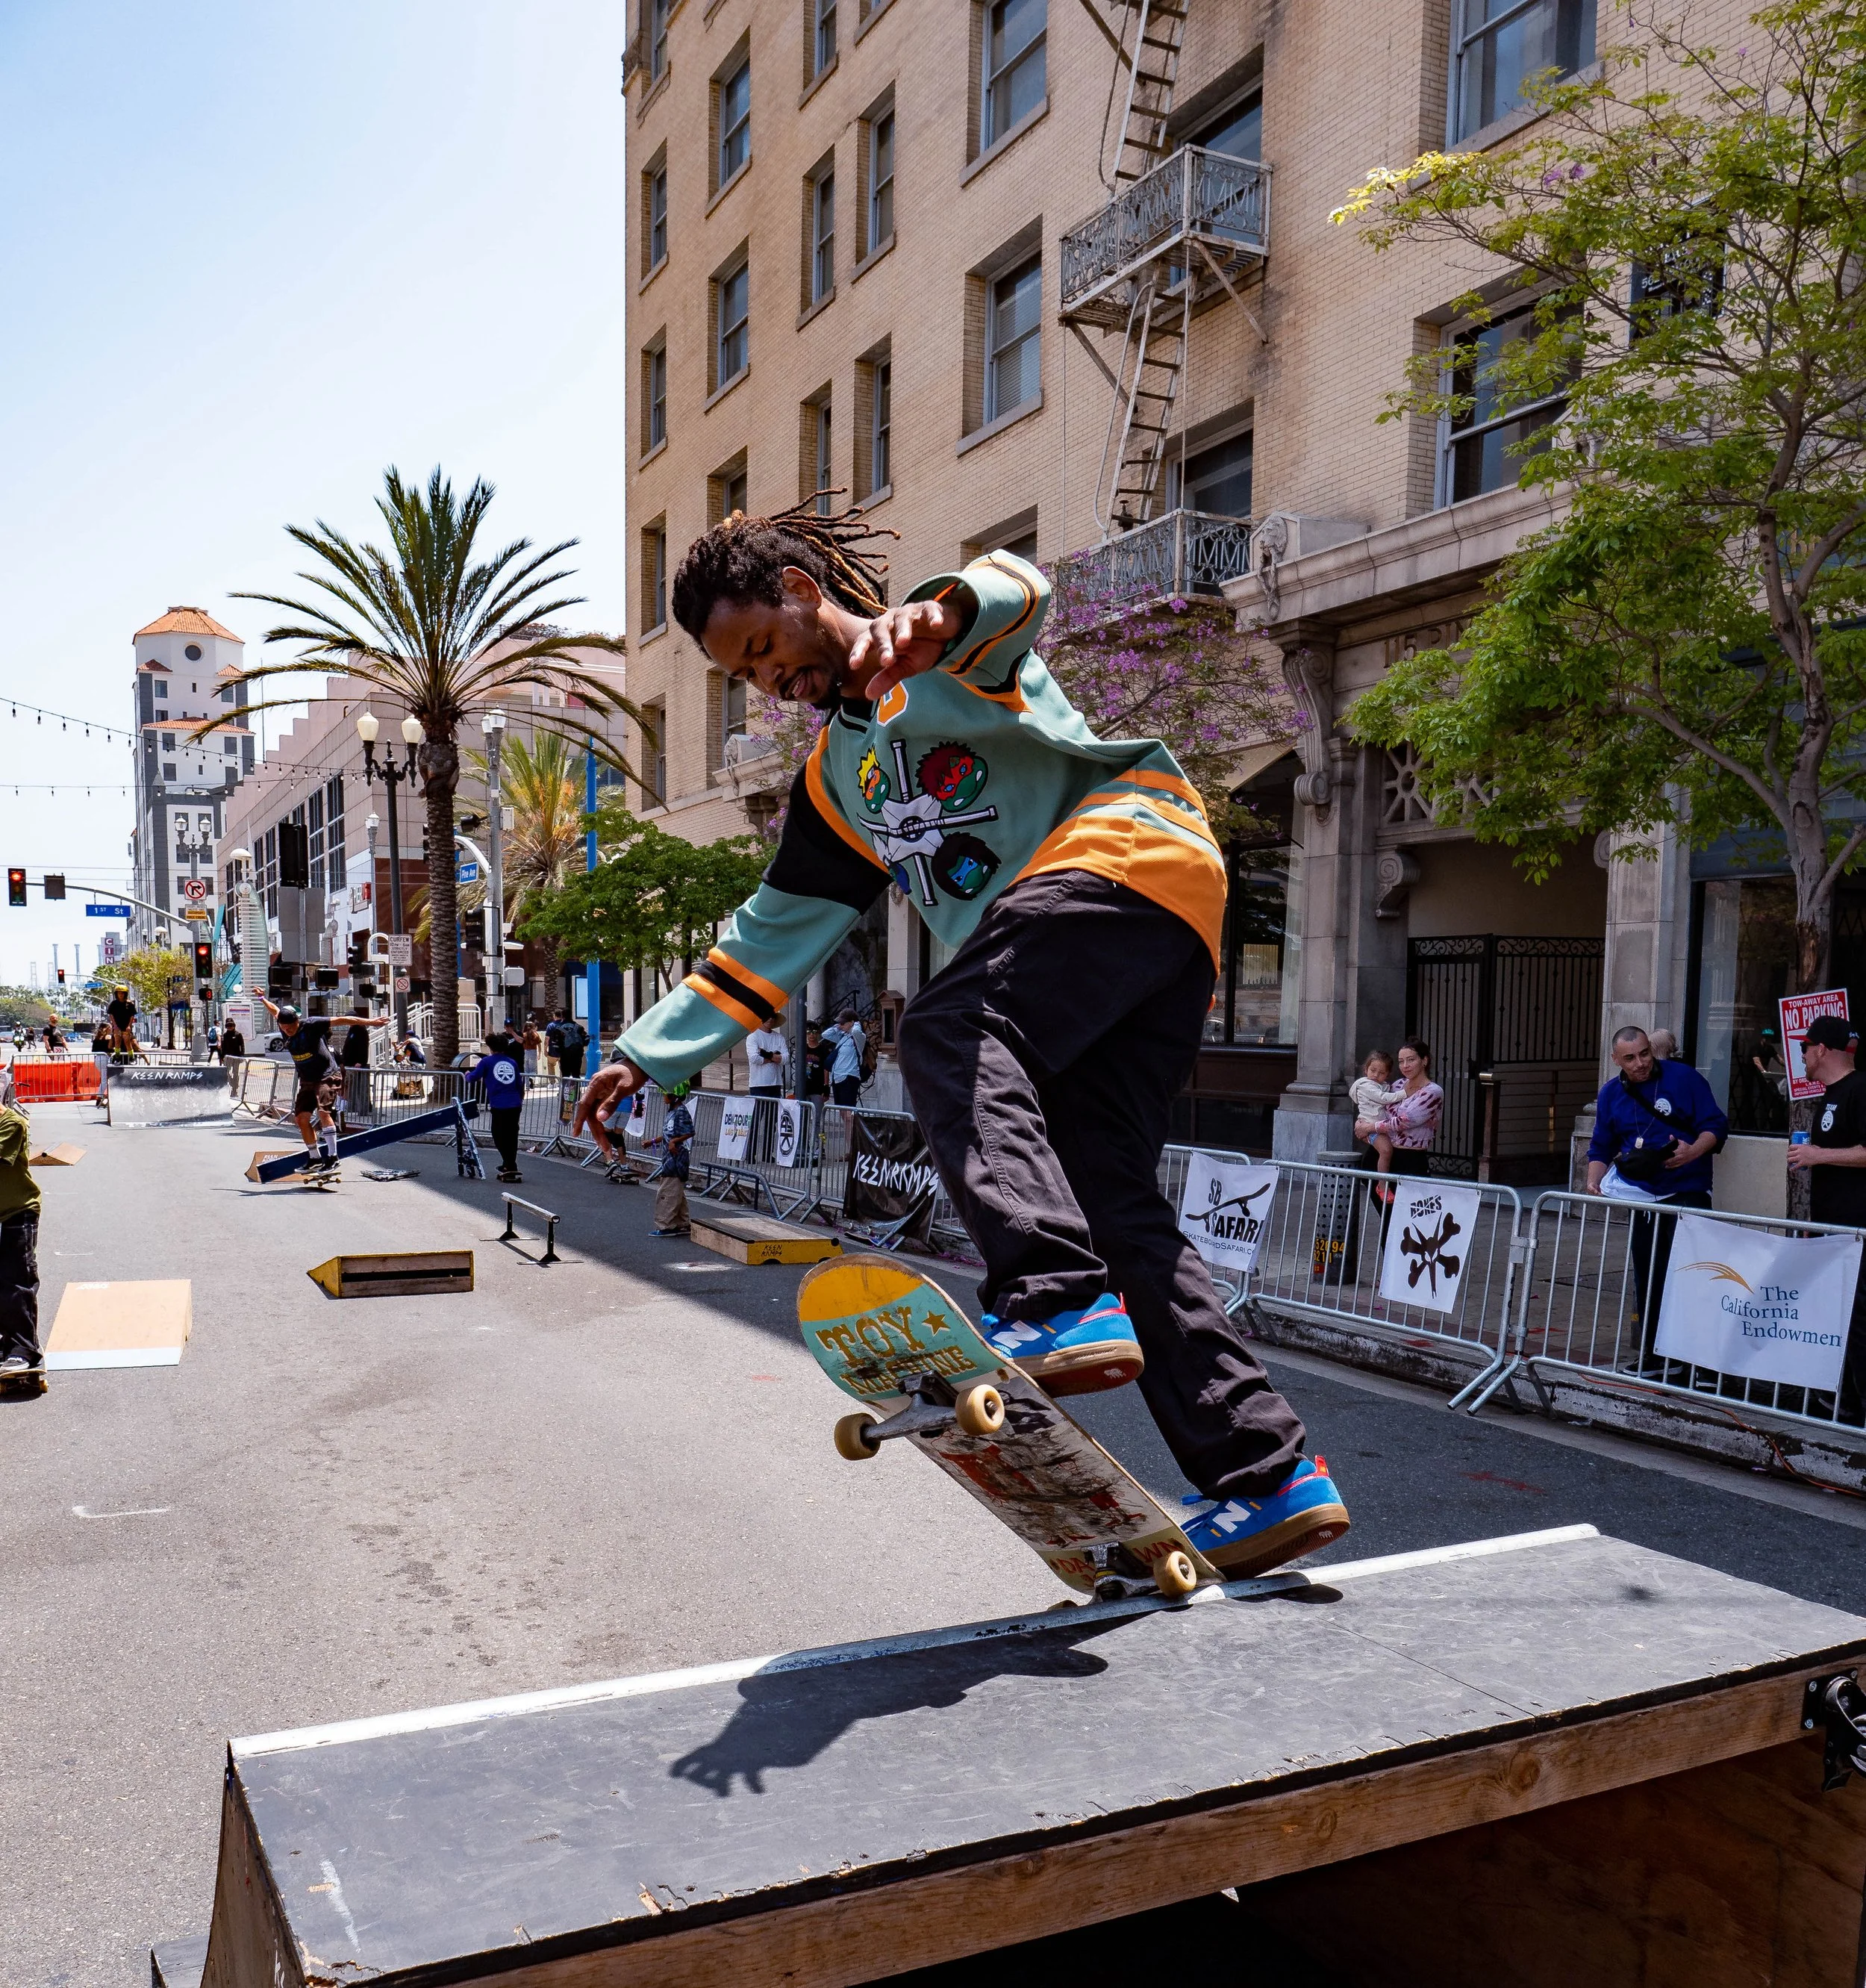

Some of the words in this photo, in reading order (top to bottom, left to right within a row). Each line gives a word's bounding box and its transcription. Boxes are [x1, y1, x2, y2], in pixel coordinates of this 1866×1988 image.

[1788, 997, 1820, 1008] TOW-AWAY
[1823, 994, 1838, 1003] AREA
[1785, 1009, 1800, 1030] NO
[131, 1071, 164, 1080] KEEN
[165, 1071, 204, 1080] RAMPS
[853, 1151, 890, 1187] KEEN
[890, 1161, 939, 1196] RAMPS
[1208, 1178, 1223, 1206] SB
[1410, 1194, 1442, 1219] BONES
[1211, 1212, 1264, 1244] SAFARI
[1760, 1286, 1799, 1301] The
[1721, 1294, 1799, 1320] California
[815, 1306, 926, 1369] TOY
